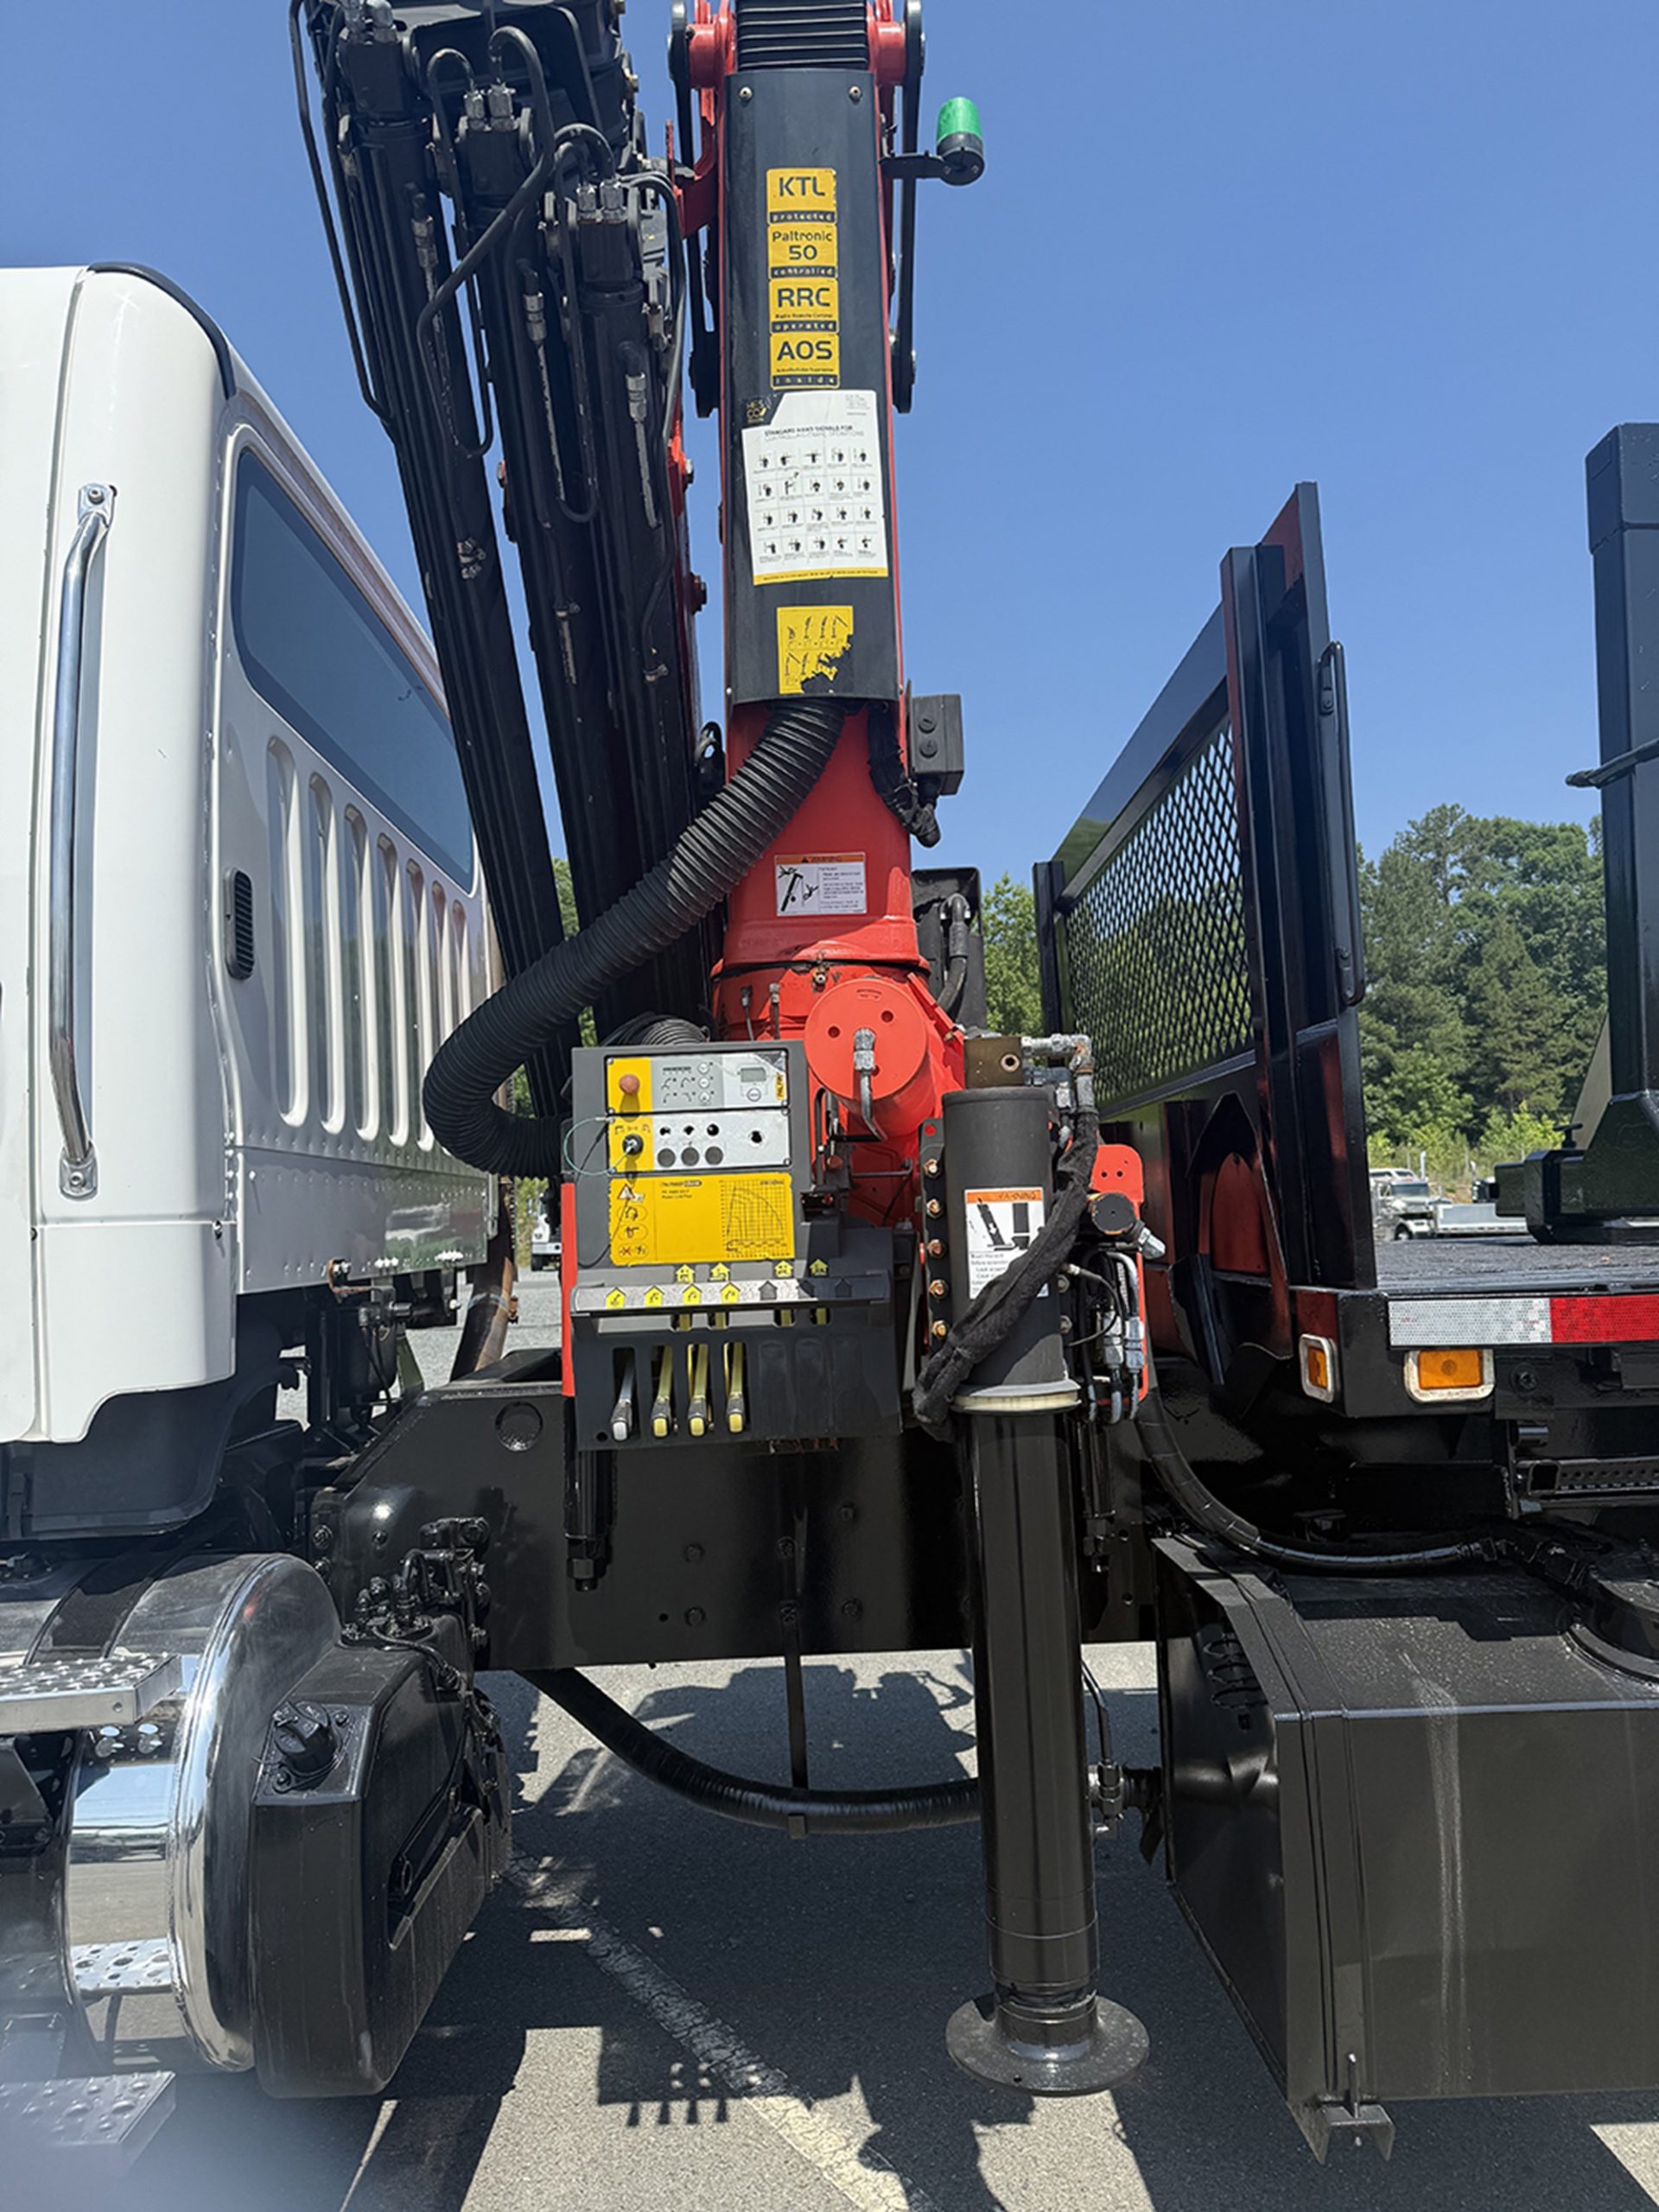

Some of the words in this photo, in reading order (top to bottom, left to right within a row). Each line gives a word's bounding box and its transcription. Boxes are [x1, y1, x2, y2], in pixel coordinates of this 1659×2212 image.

[779, 176, 826, 197] KTL
[772, 213, 832, 222] protected
[772, 230, 833, 242] Paltronic
[789, 245, 817, 261] 50
[773, 267, 834, 276] controlled
[778, 287, 830, 308] RRC
[774, 321, 834, 331] operated
[777, 340, 832, 361] AOS
